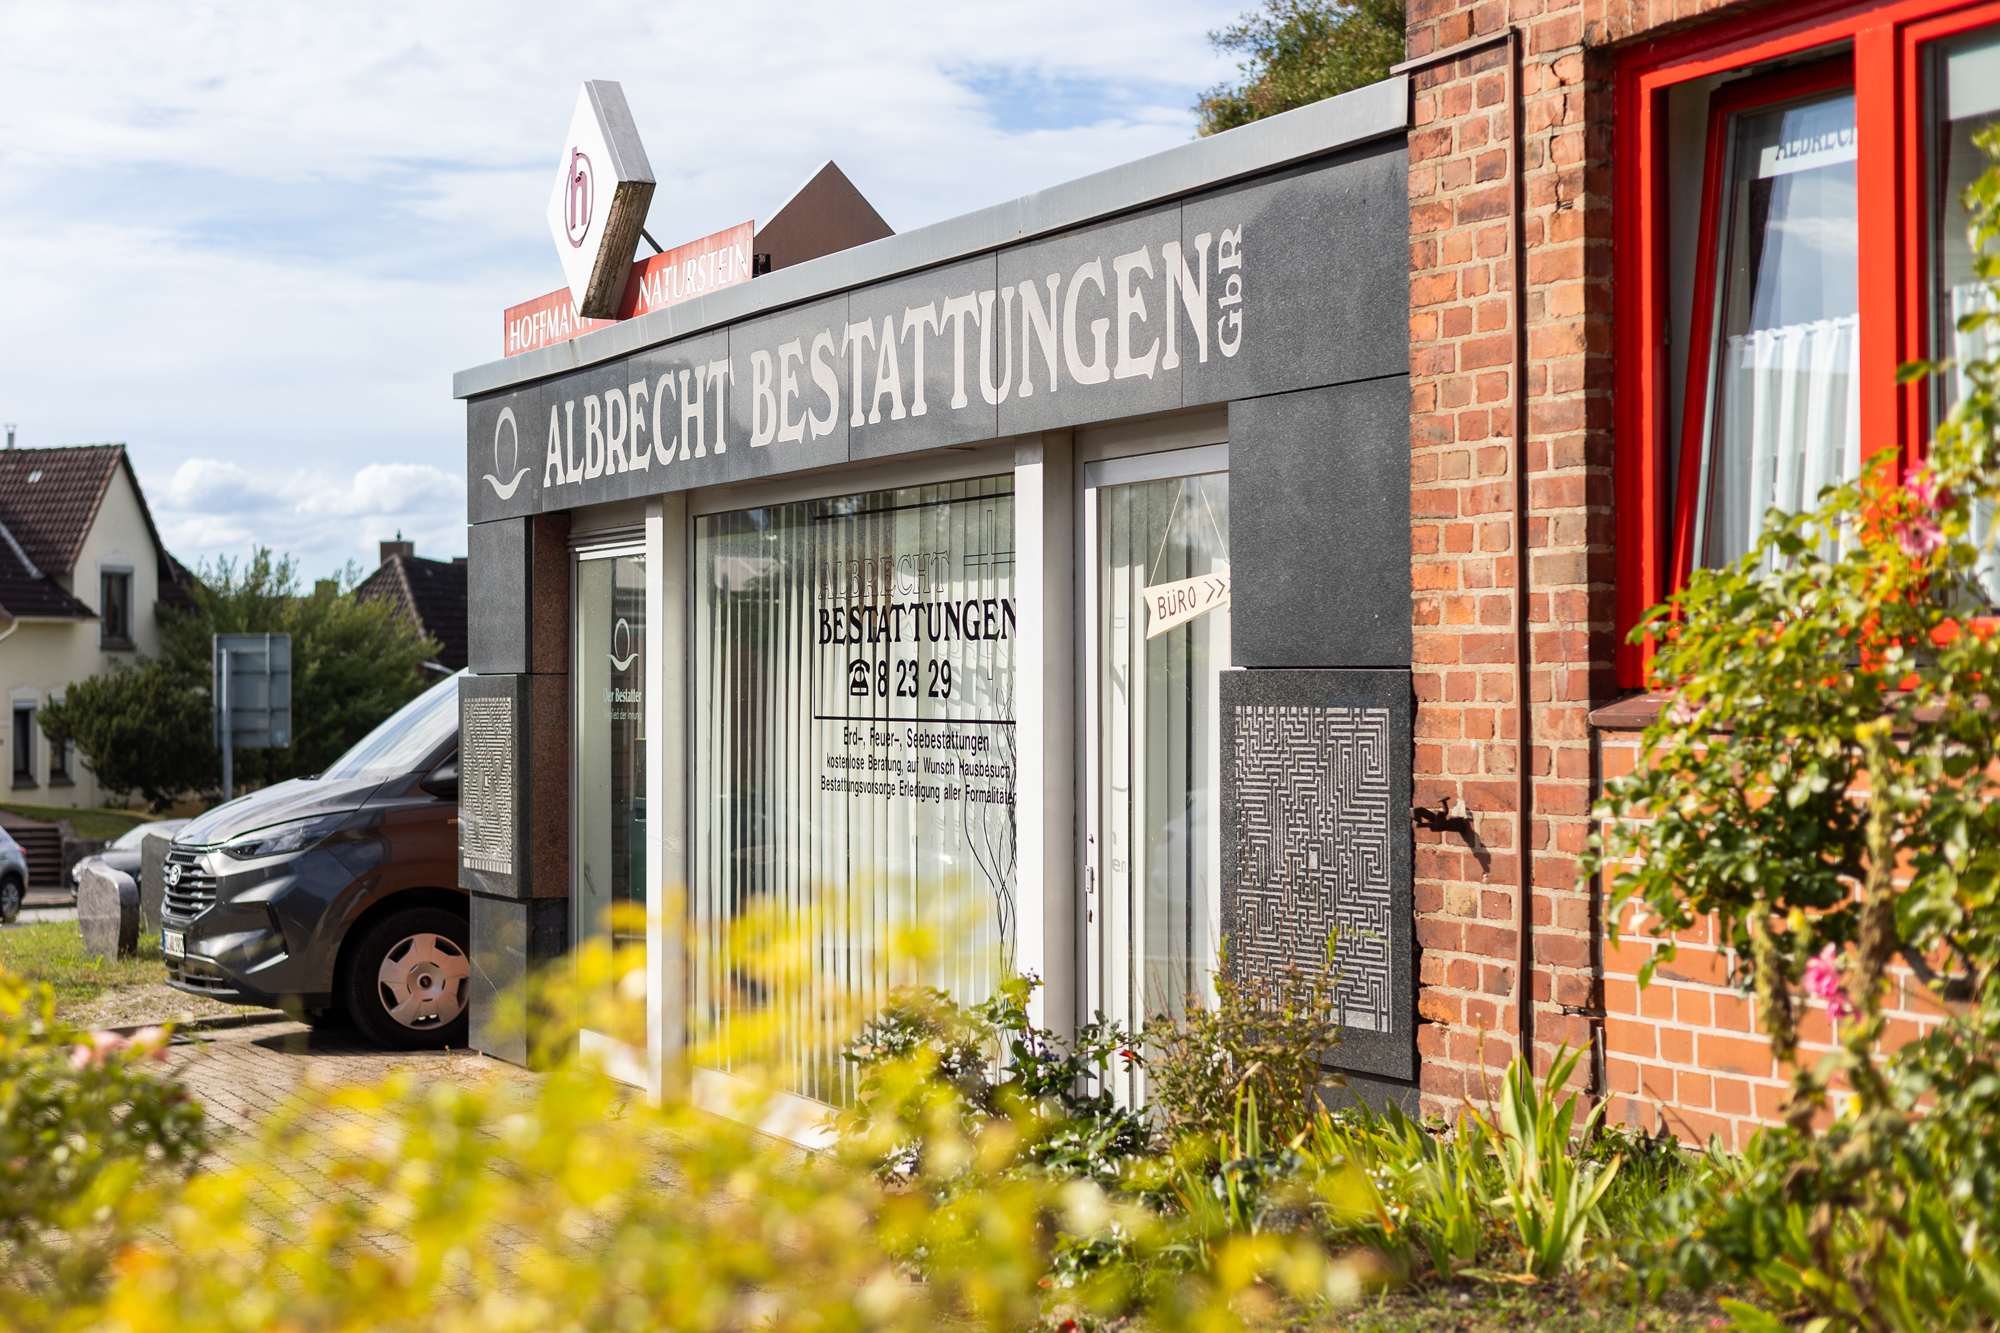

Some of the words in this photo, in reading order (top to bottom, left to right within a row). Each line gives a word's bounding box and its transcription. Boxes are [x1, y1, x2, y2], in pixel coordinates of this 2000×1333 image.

[510, 300, 592, 352] HOFFMAN
[638, 239, 750, 311] NATURSTEIN
[543, 355, 735, 488] ALBRECHT
[750, 232, 1212, 448] BESTATTUNGEN
[1218, 224, 1242, 357] GbR
[818, 551, 950, 600] ALBRECHT
[818, 598, 1016, 644] BESTATTUNGEN
[1157, 586, 1196, 620] BÜRO
[615, 687, 642, 703] Bestatter
[877, 660, 888, 697] 8
[896, 659, 919, 698] 23
[928, 659, 951, 699] 29
[906, 728, 990, 756] Seebestattungen
[826, 752, 865, 770] kostenlose
[868, 755, 904, 776] Beratung,
[907, 757, 919, 773] auf
[923, 757, 955, 775] Wunsch
[960, 759, 1011, 778] Hausbesuch
[821, 775, 896, 799] Bestattungsvorsorge
[899, 780, 940, 804] Erledigung
[944, 783, 961, 800] aller
